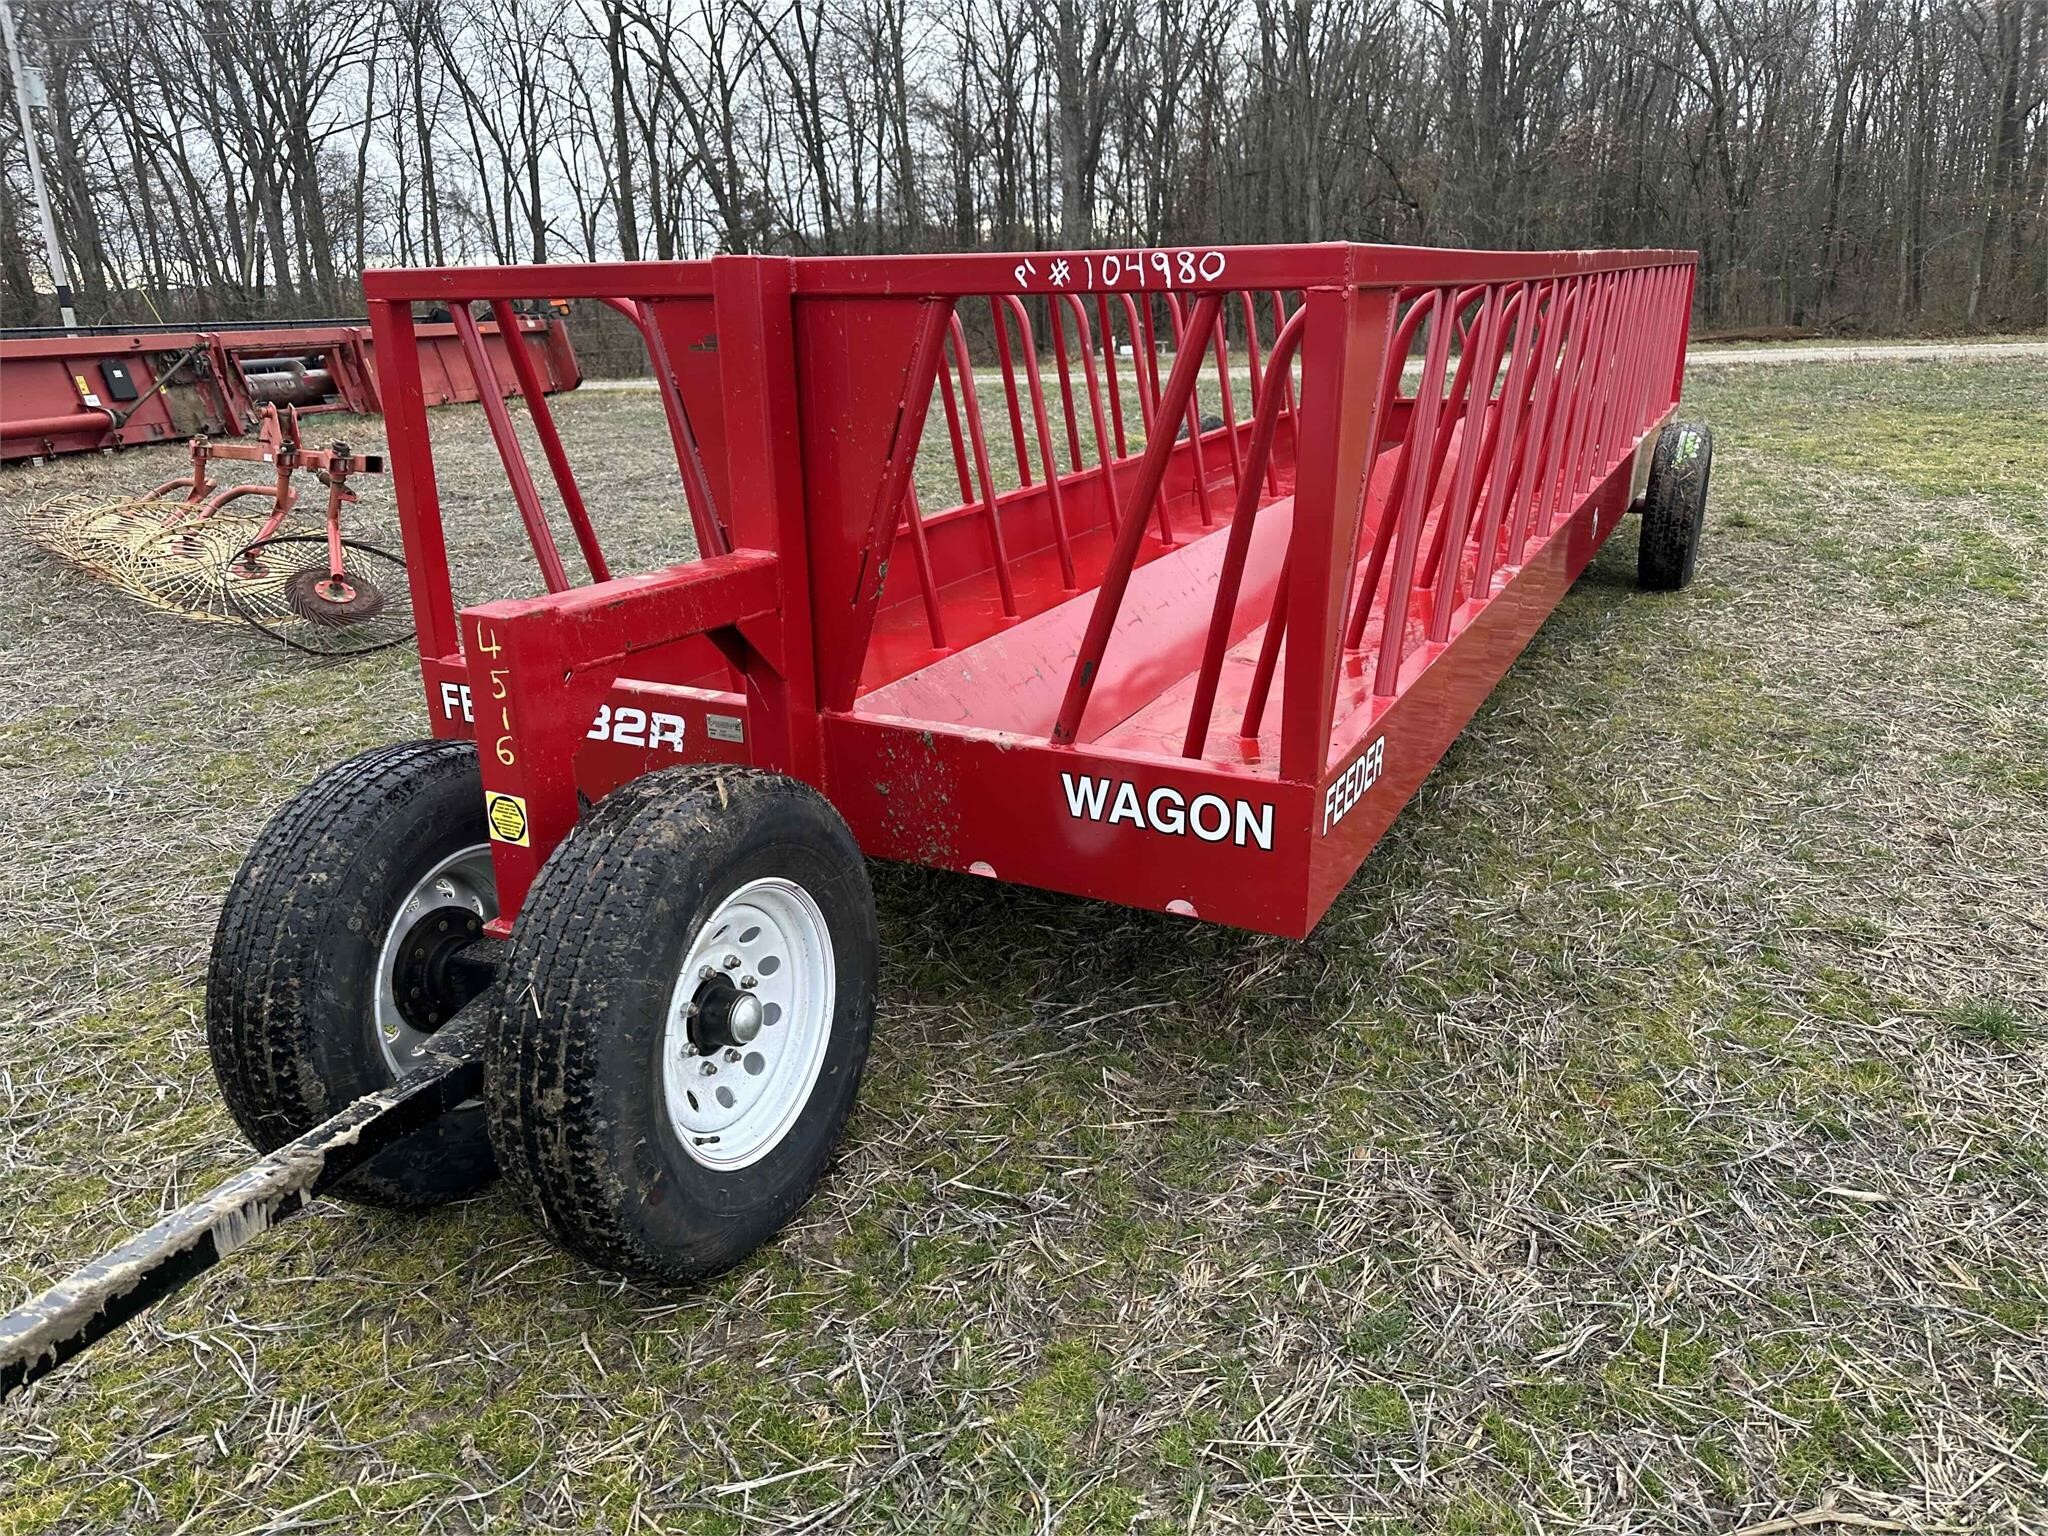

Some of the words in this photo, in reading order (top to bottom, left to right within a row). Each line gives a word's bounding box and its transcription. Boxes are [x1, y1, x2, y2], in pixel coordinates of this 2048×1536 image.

[440, 682, 475, 723] FE
[1061, 772, 1274, 851] WAGON
[1322, 735, 1386, 837] FEEDER
